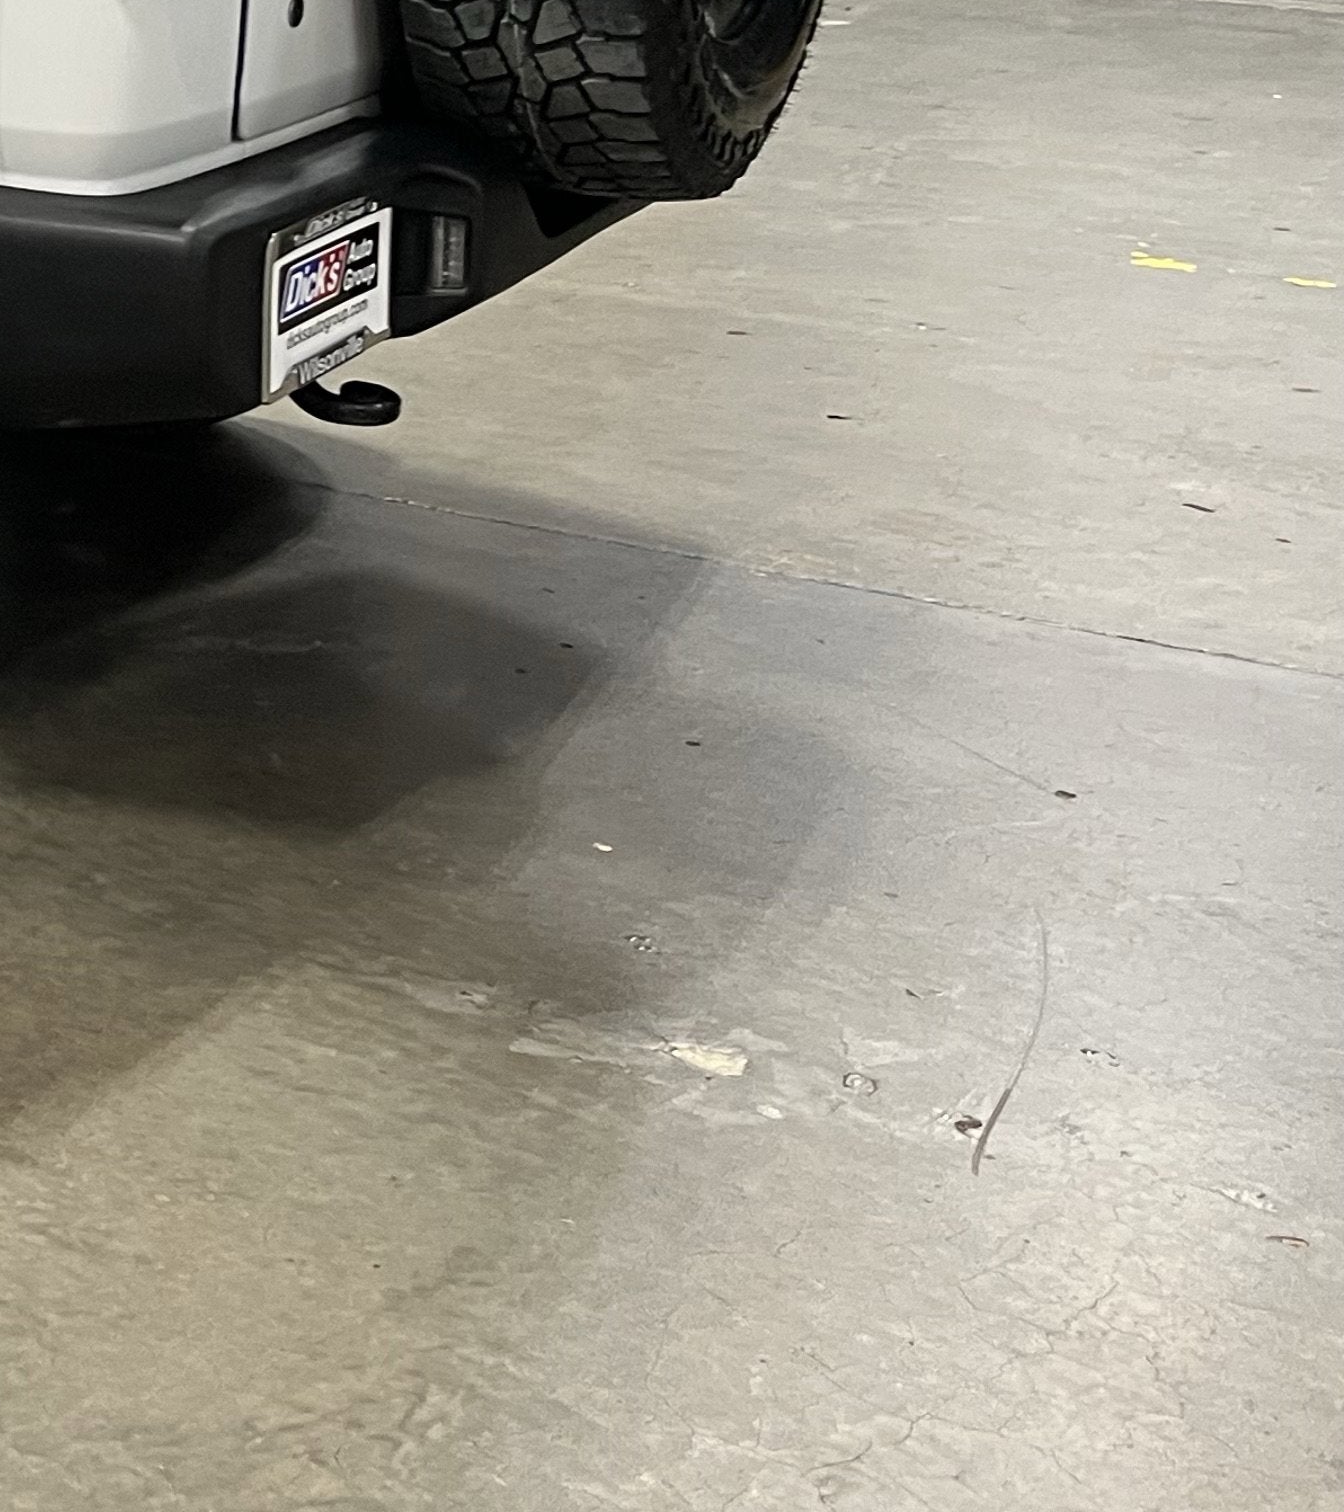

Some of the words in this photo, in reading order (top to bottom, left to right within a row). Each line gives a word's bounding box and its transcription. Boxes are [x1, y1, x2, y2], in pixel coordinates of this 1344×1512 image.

[346, 238, 374, 265] Auto
[284, 253, 341, 313] Dick's
[343, 263, 376, 291] Group
